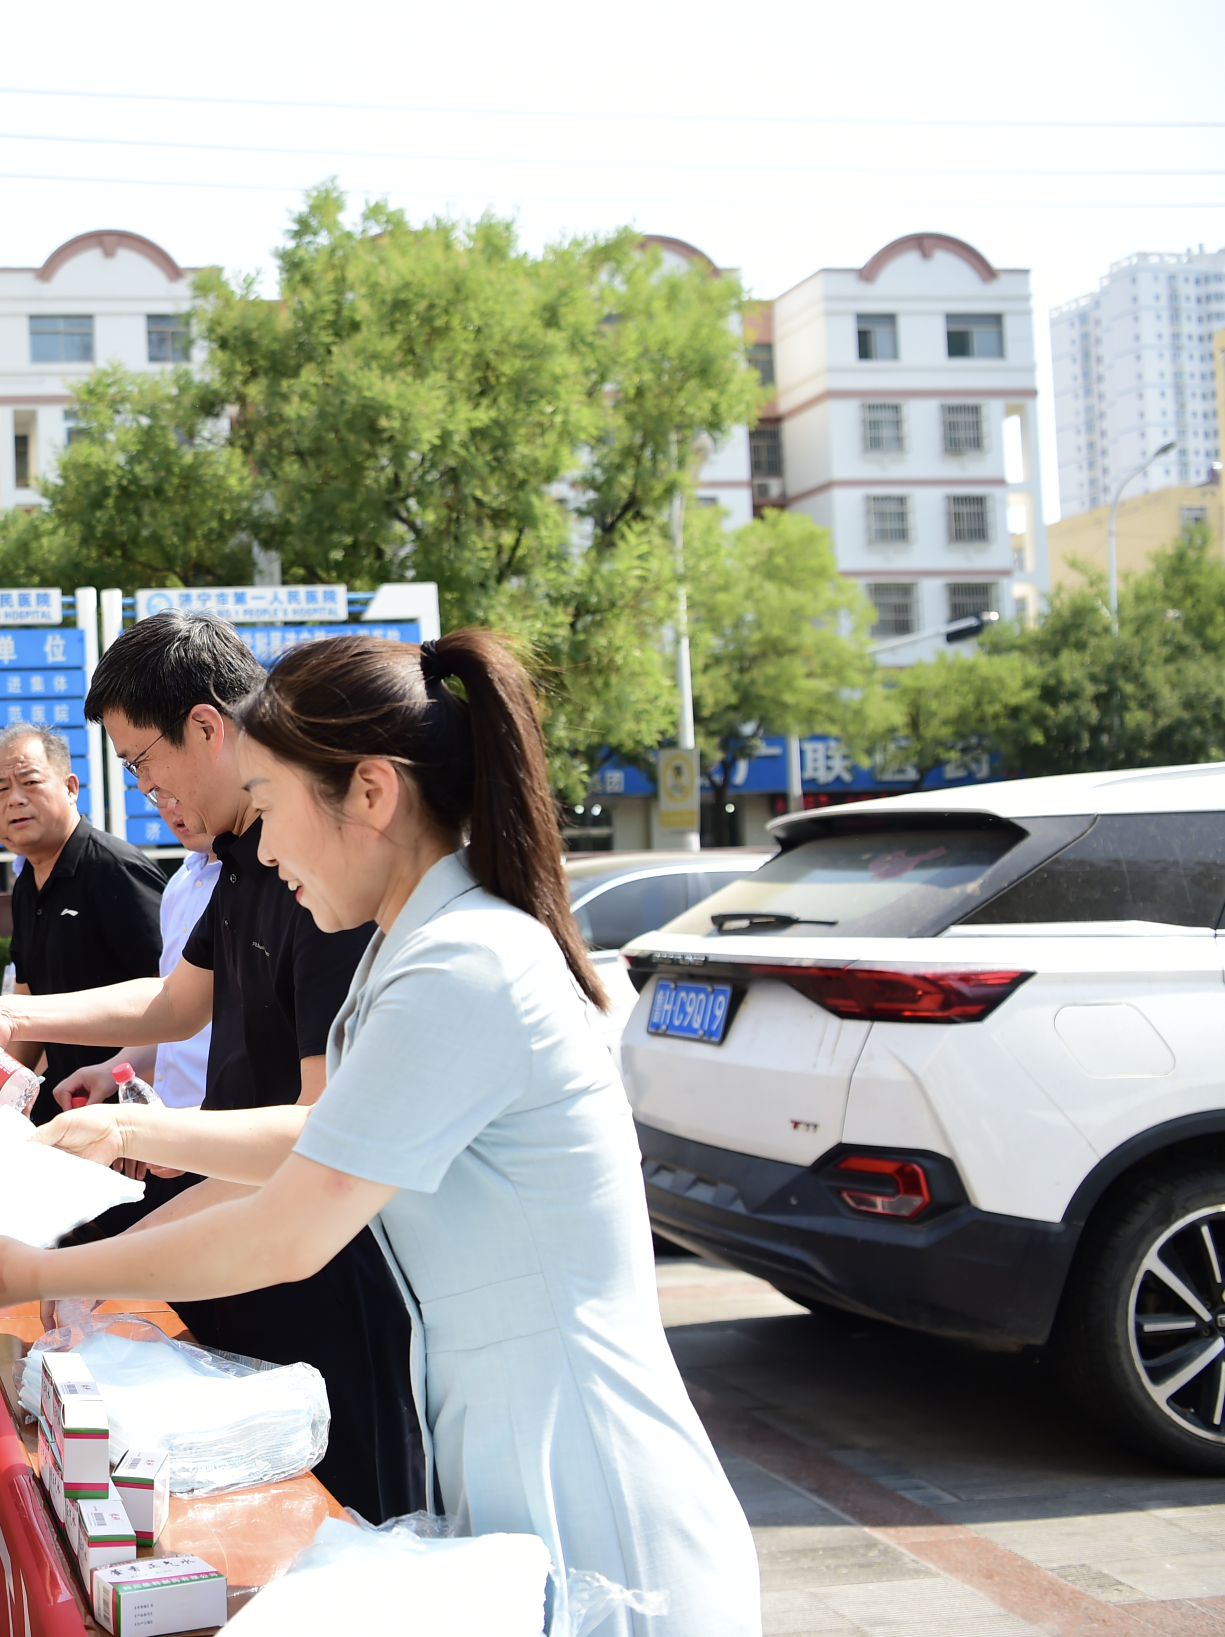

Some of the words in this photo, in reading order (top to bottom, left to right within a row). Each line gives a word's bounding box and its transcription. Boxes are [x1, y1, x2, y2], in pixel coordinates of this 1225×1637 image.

[179, 589, 338, 608] 济宁市第一人民医院
[4, 610, 52, 621] HOSPITAL
[292, 606, 338, 617] HOSPITAL
